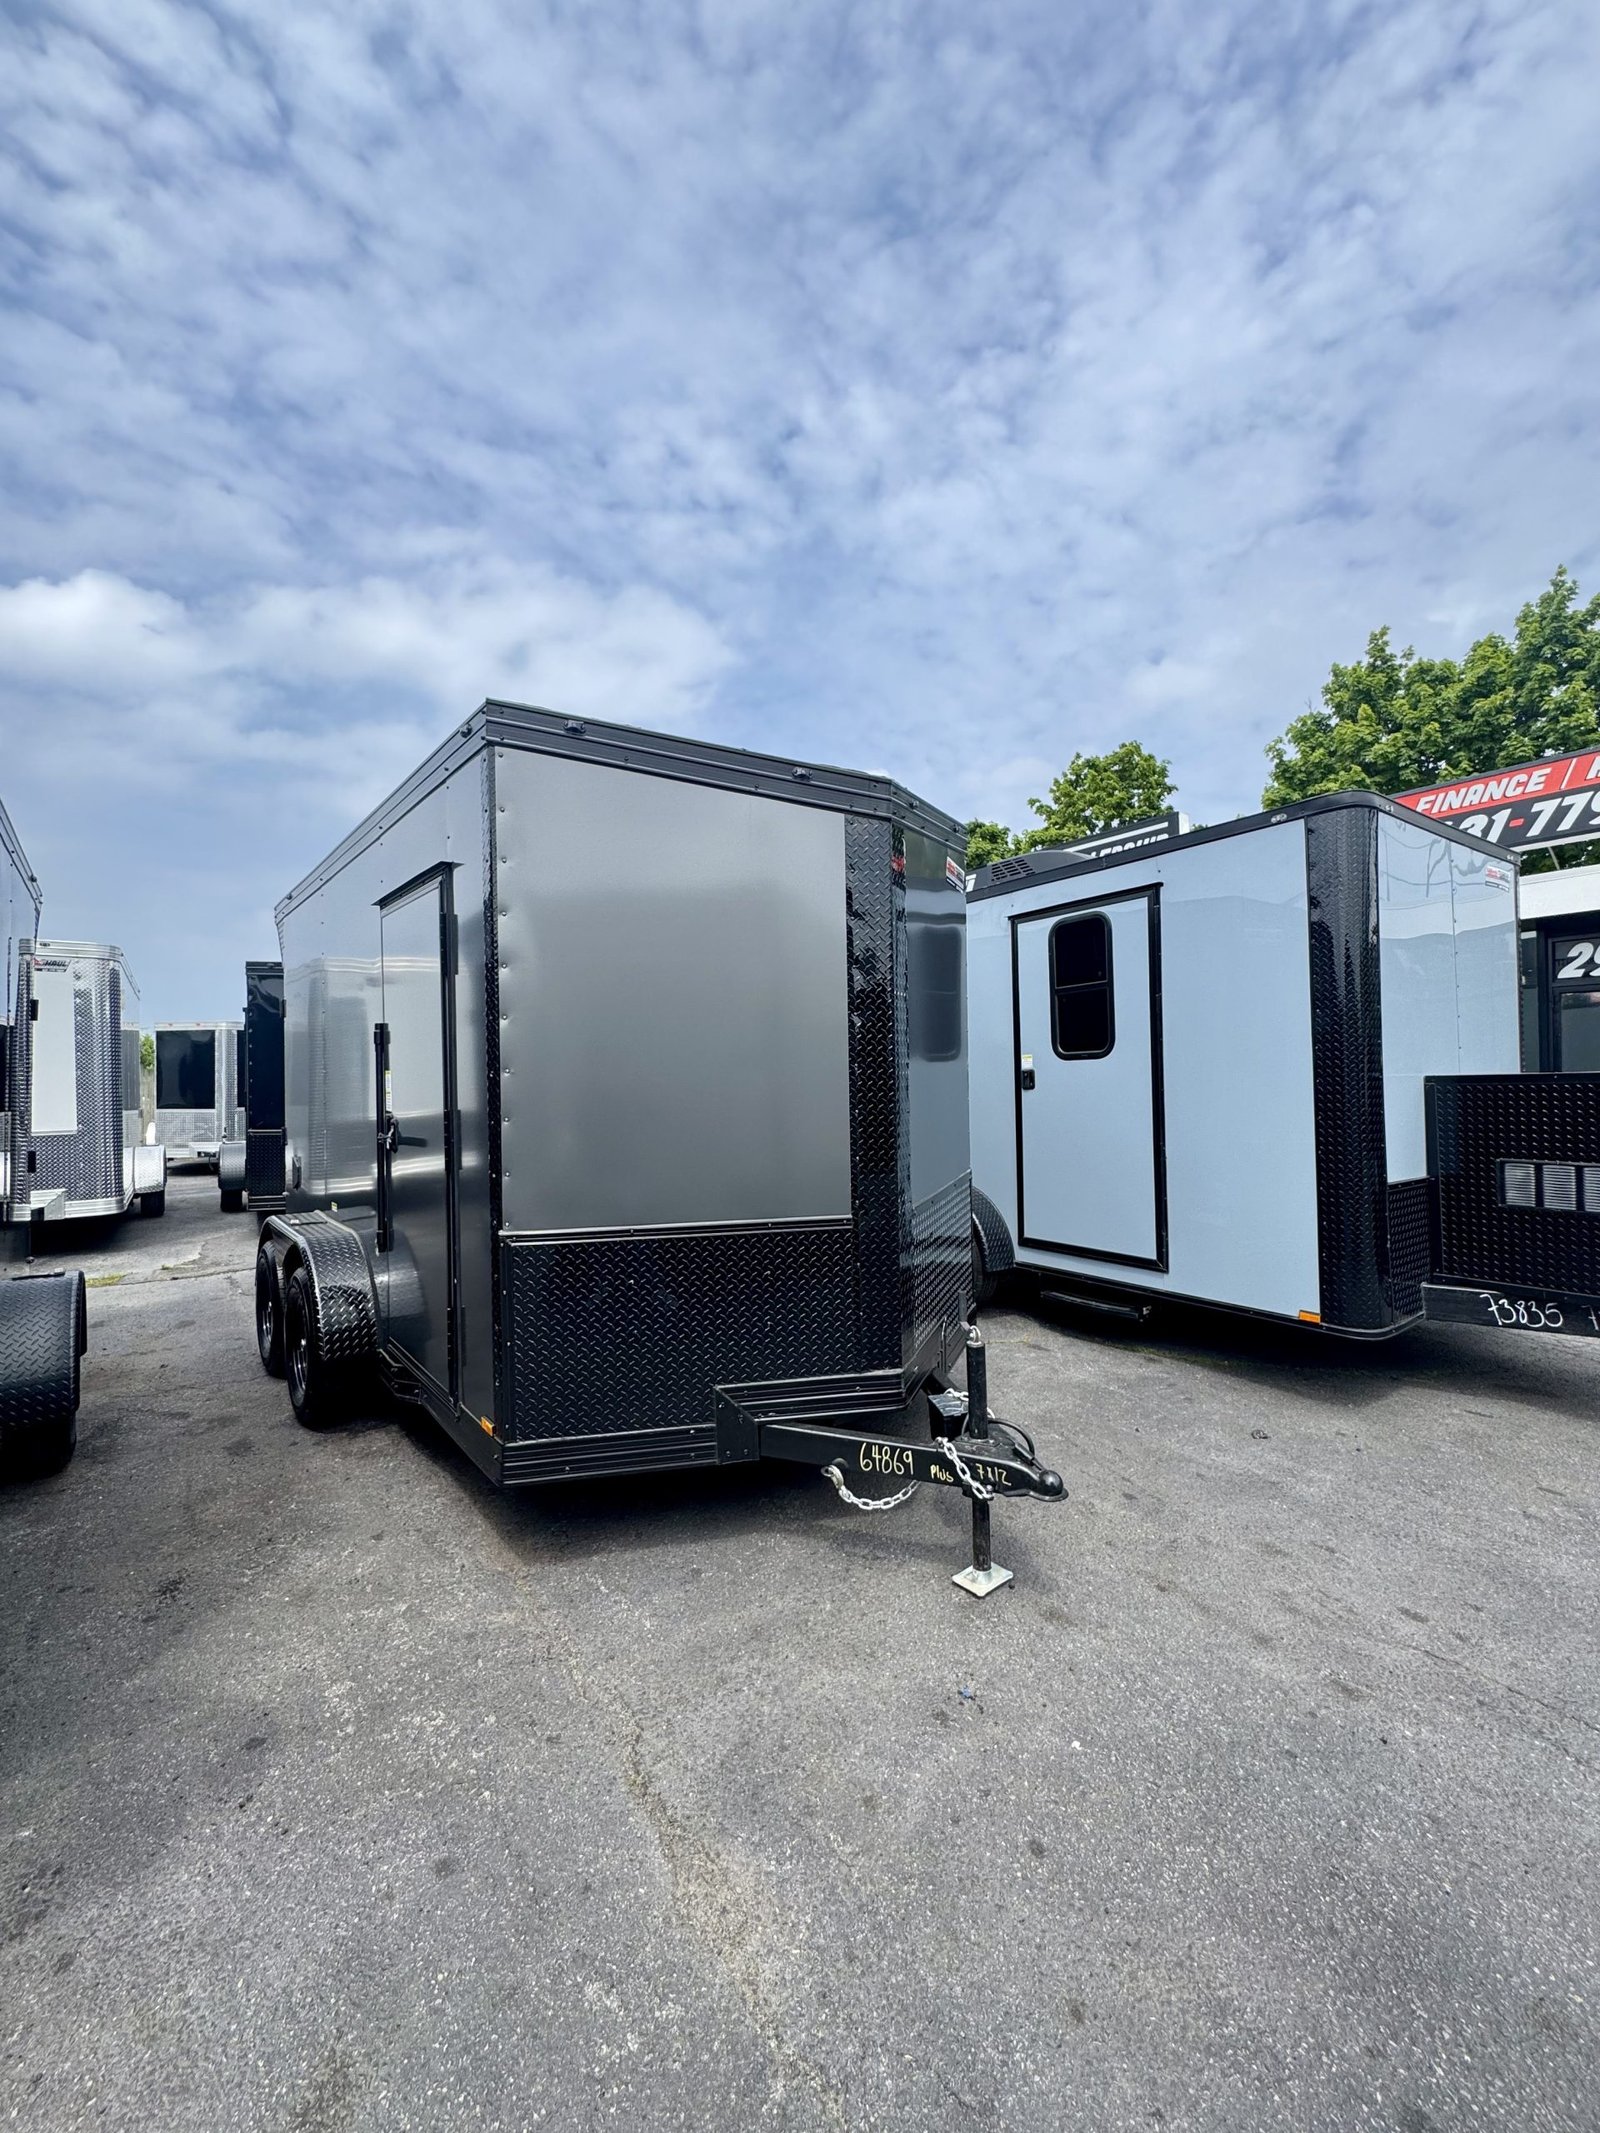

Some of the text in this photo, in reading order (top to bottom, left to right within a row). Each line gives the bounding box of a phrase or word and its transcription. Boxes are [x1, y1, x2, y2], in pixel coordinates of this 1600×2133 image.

[1415, 767, 1552, 814] FINANCE
[1443, 790, 1600, 843] 31-77
[1480, 1293, 1600, 1330] 73835 7
[859, 1442, 914, 1475] 64869
